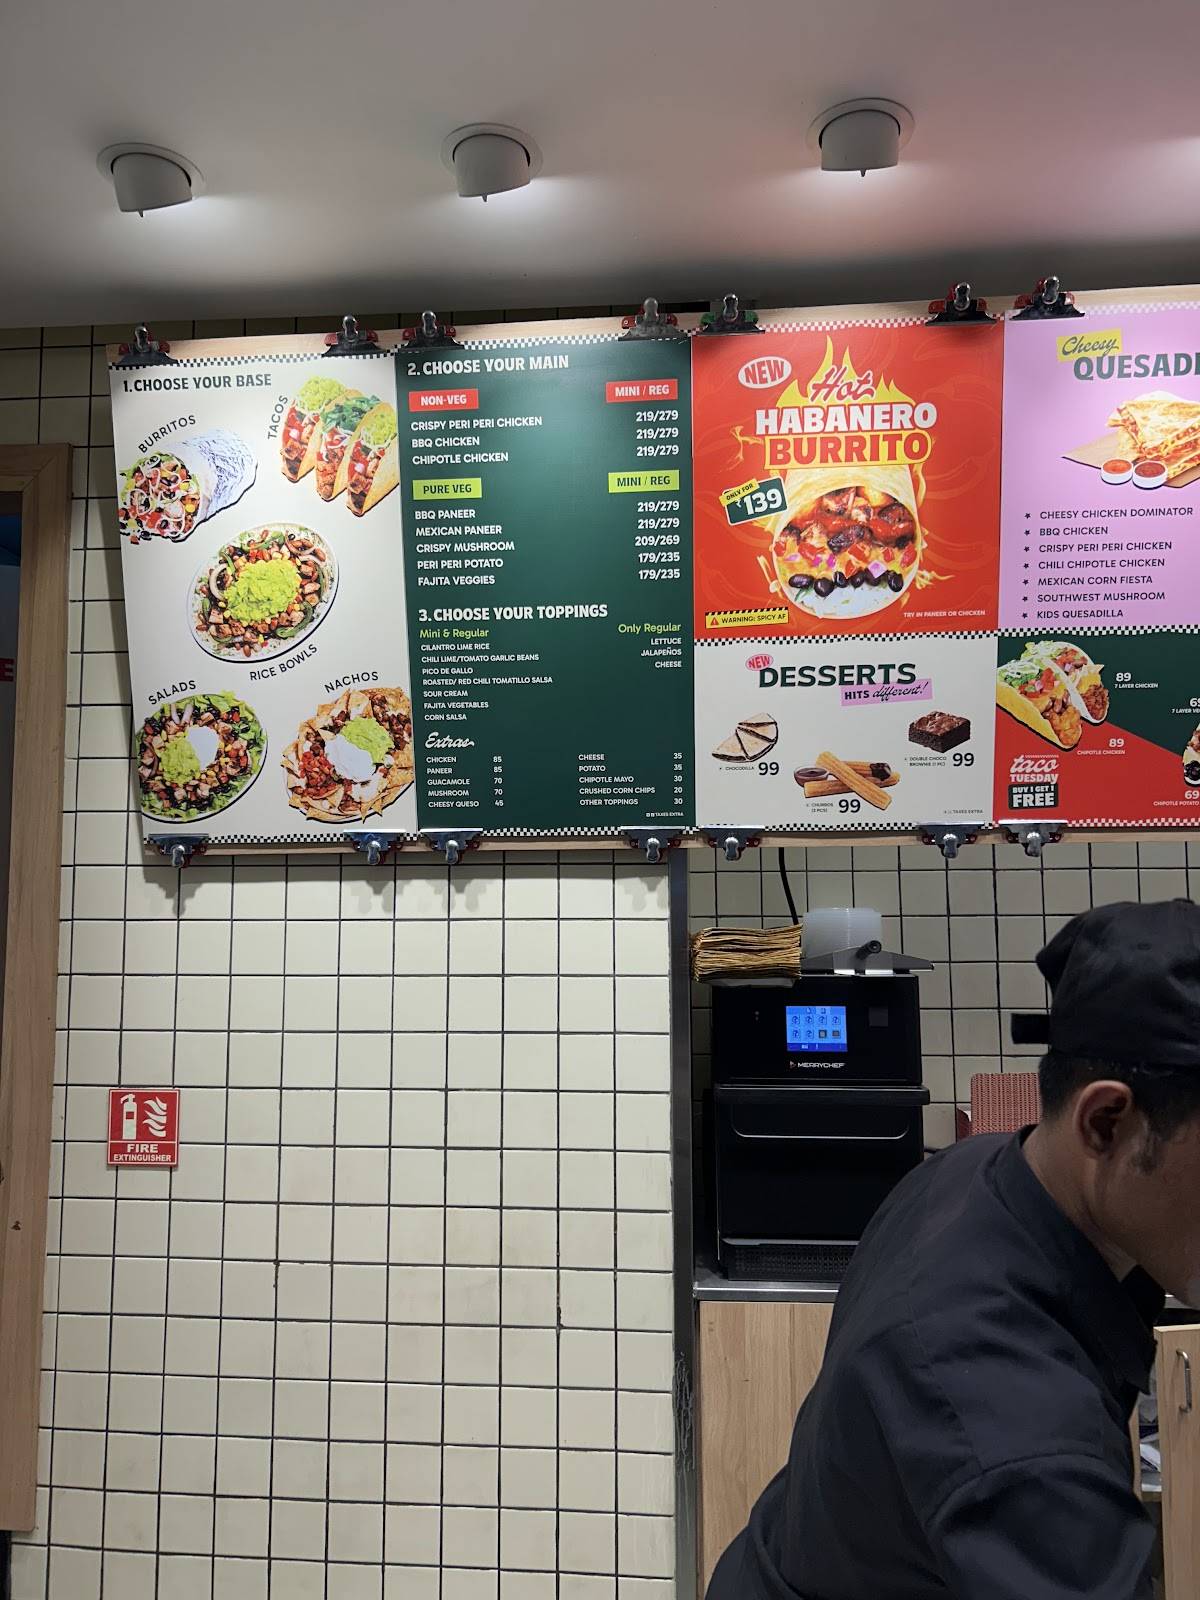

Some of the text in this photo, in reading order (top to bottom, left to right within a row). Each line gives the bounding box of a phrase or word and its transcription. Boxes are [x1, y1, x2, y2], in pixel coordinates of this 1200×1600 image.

[1062, 336, 1120, 361] Cheesy
[484, 357, 524, 372] YOUR
[530, 355, 569, 370] MAIN
[744, 362, 785, 384] NEW
[193, 376, 231, 389] YOUR
[236, 374, 272, 387] BASE
[810, 366, 876, 402] Hot
[615, 385, 669, 397] MINI REG
[421, 395, 467, 406] NON-VEG
[267, 395, 288, 439] TACOS
[636, 410, 678, 422] 219/279
[756, 403, 937, 434] HABANERO
[411, 417, 542, 431] CRISPY PERI PERI CHICKEN
[138, 415, 196, 453] BURRITOS
[636, 428, 678, 439] 219/279
[412, 437, 480, 448] BBQ CHICKEN
[637, 445, 679, 456] 219/279
[769, 434, 928, 465] BURRITO
[412, 452, 509, 465] CHIPOTLE CHICKEN
[617, 475, 671, 487] MINI REG
[423, 484, 472, 494] PURE VEG
[726, 483, 753, 500] ONLY FOR
[638, 501, 679, 512] 219/279
[415, 510, 475, 520] BBQ PANEER
[1040, 508, 1193, 519] CHEESY CHICKEN DOMINATOR
[638, 518, 679, 529] 219/279
[416, 525, 502, 536] MEXICAN PANEER
[1040, 526, 1108, 536] BBQ CHICKEN
[635, 535, 680, 546] 209/269
[416, 541, 514, 553] CRISPY MUSHROOM
[1039, 542, 1172, 552] CRISPY PERI PERI CHICKEN
[639, 552, 680, 563] 179/235
[417, 558, 503, 570] PERI PERI POTATO
[1038, 558, 1165, 569] CHILI CHIPOTLE CHICKEN
[639, 569, 680, 580] 179/235
[418, 575, 495, 586] FAJITA VEGGIES
[1038, 575, 1152, 586] MEXICAN CORN FIESTA
[1037, 592, 1165, 602] SOUTHWEST MUSHROOM
[493, 607, 533, 620] YOUR
[537, 605, 608, 618] TOPPINGS
[1037, 609, 1123, 618] KIDS QUESADILLA
[722, 614, 774, 624] WARNING: SPICY
[420, 628, 489, 639] Mini & Regular
[618, 623, 681, 634] Only Regular
[641, 647, 681, 657] JALAPEÑOS
[250, 644, 318, 680] RICE BOWLS
[748, 656, 770, 668] NEW
[760, 664, 916, 688] DESSERTS
[1116, 673, 1131, 682] 89
[324, 672, 378, 693] NACHOS
[148, 680, 196, 705] SALADS
[844, 682, 929, 702] HITS different!
[448, 701, 489, 709] VEGETABLES
[425, 732, 474, 748] Extras
[1109, 739, 1124, 747] 89
[952, 753, 974, 766] 99
[1010, 755, 1058, 773] taco
[758, 762, 779, 775] 99
[1010, 774, 1058, 784] TUESDAY
[1013, 793, 1054, 807] FREE
[1185, 790, 1199, 799] 69
[838, 800, 860, 813] 99
[127, 1144, 158, 1152] FIRE
